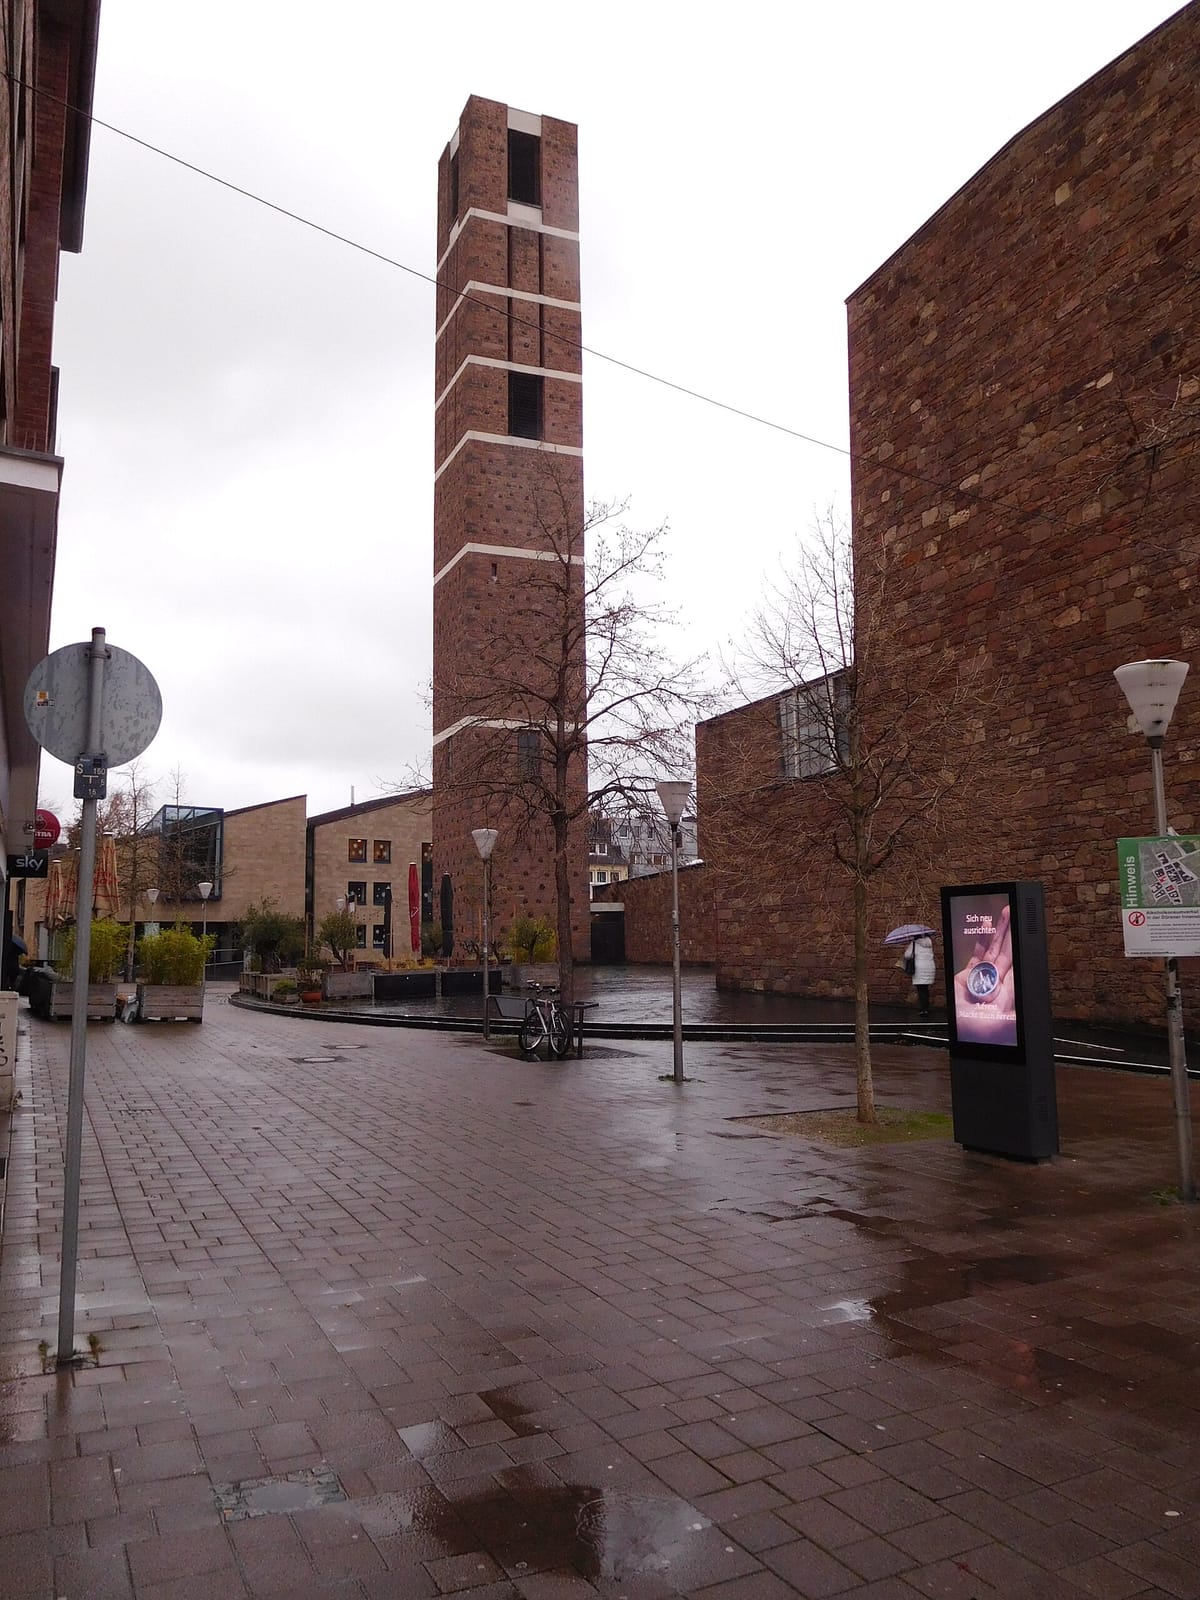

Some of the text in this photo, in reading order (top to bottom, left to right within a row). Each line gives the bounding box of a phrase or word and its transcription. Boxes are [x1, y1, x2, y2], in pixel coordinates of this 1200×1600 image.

[76, 763, 84, 774] S
[16, 856, 44, 871] sky
[1124, 855, 1139, 908] Hinweis
[966, 914, 979, 922] Sich
[964, 926, 997, 934] ausrichten
